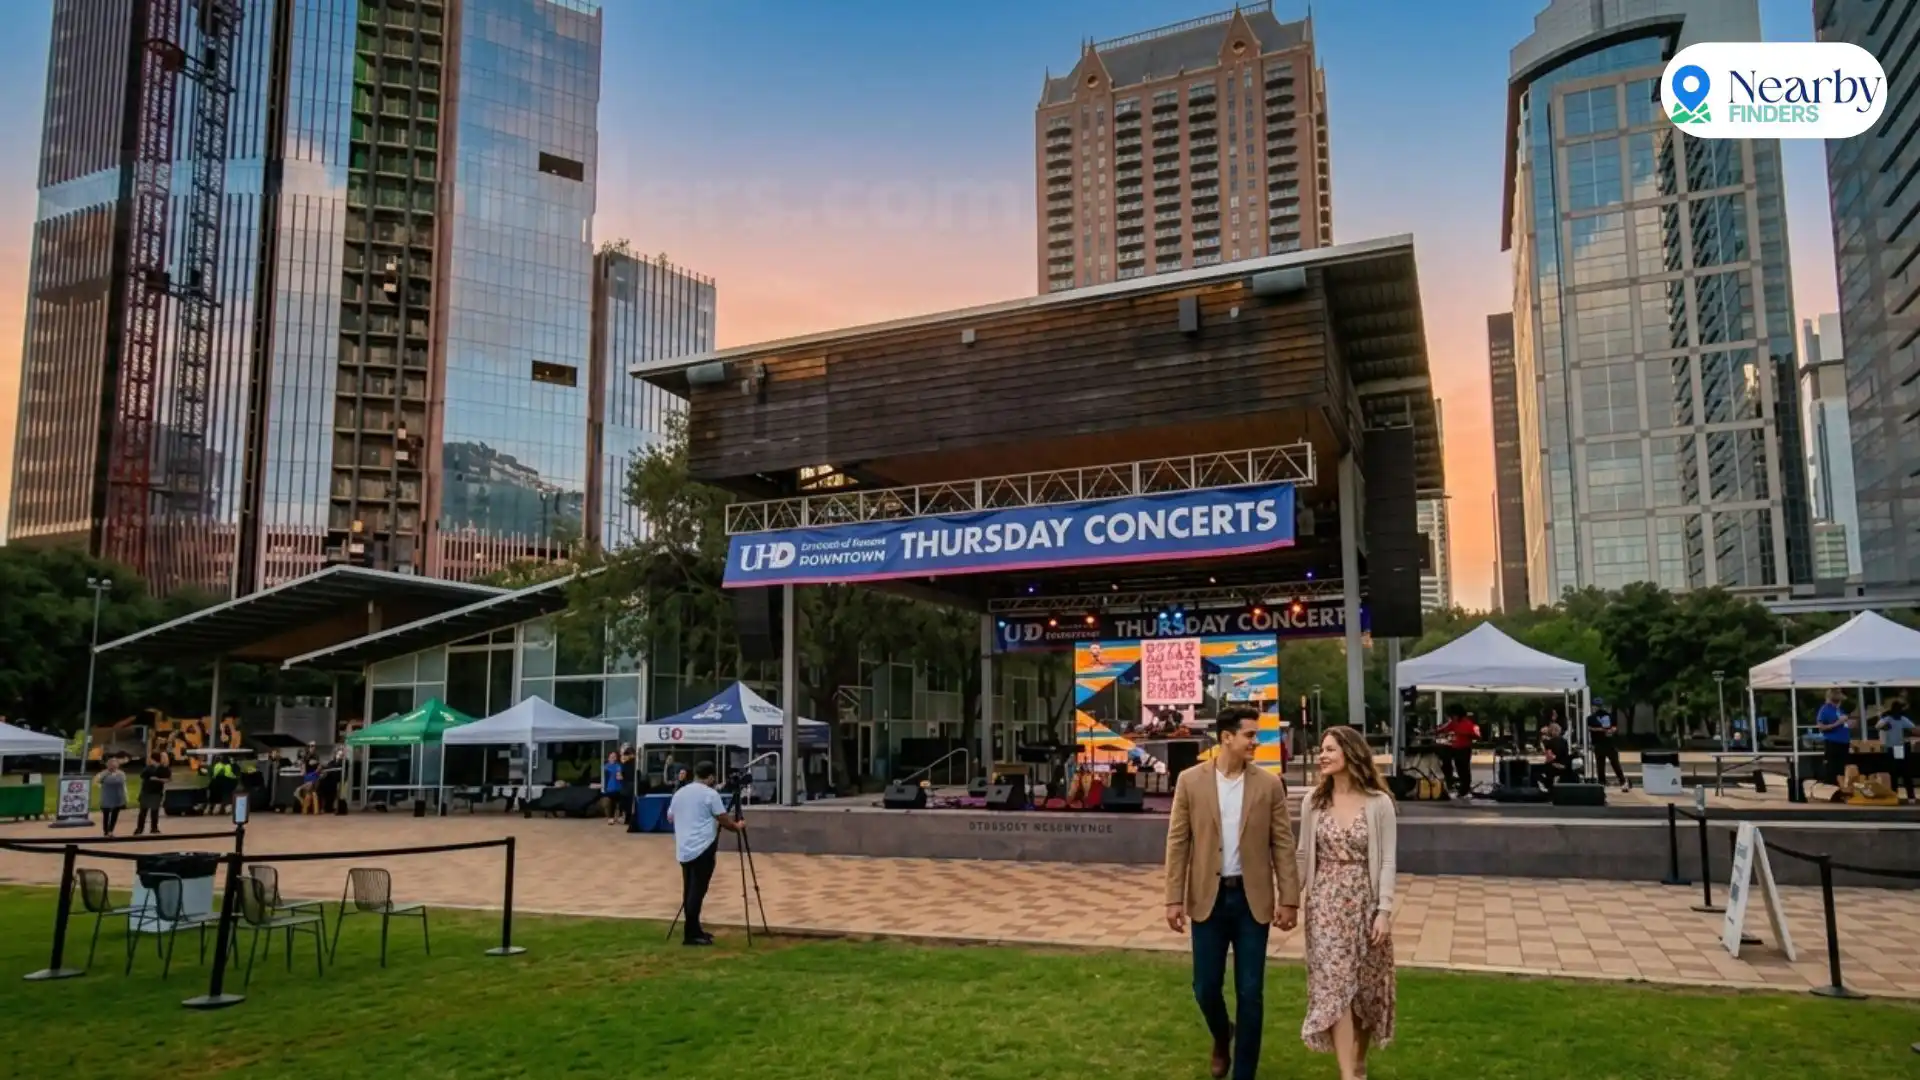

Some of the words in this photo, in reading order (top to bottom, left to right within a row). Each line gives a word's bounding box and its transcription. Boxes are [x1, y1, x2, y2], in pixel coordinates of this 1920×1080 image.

[901, 517, 1073, 559] THURSDAY
[1084, 499, 1277, 544] CONCERTS
[740, 541, 796, 572] UHD
[1115, 615, 1230, 637] THURSDAY
[1238, 607, 1363, 631] CONCERT
